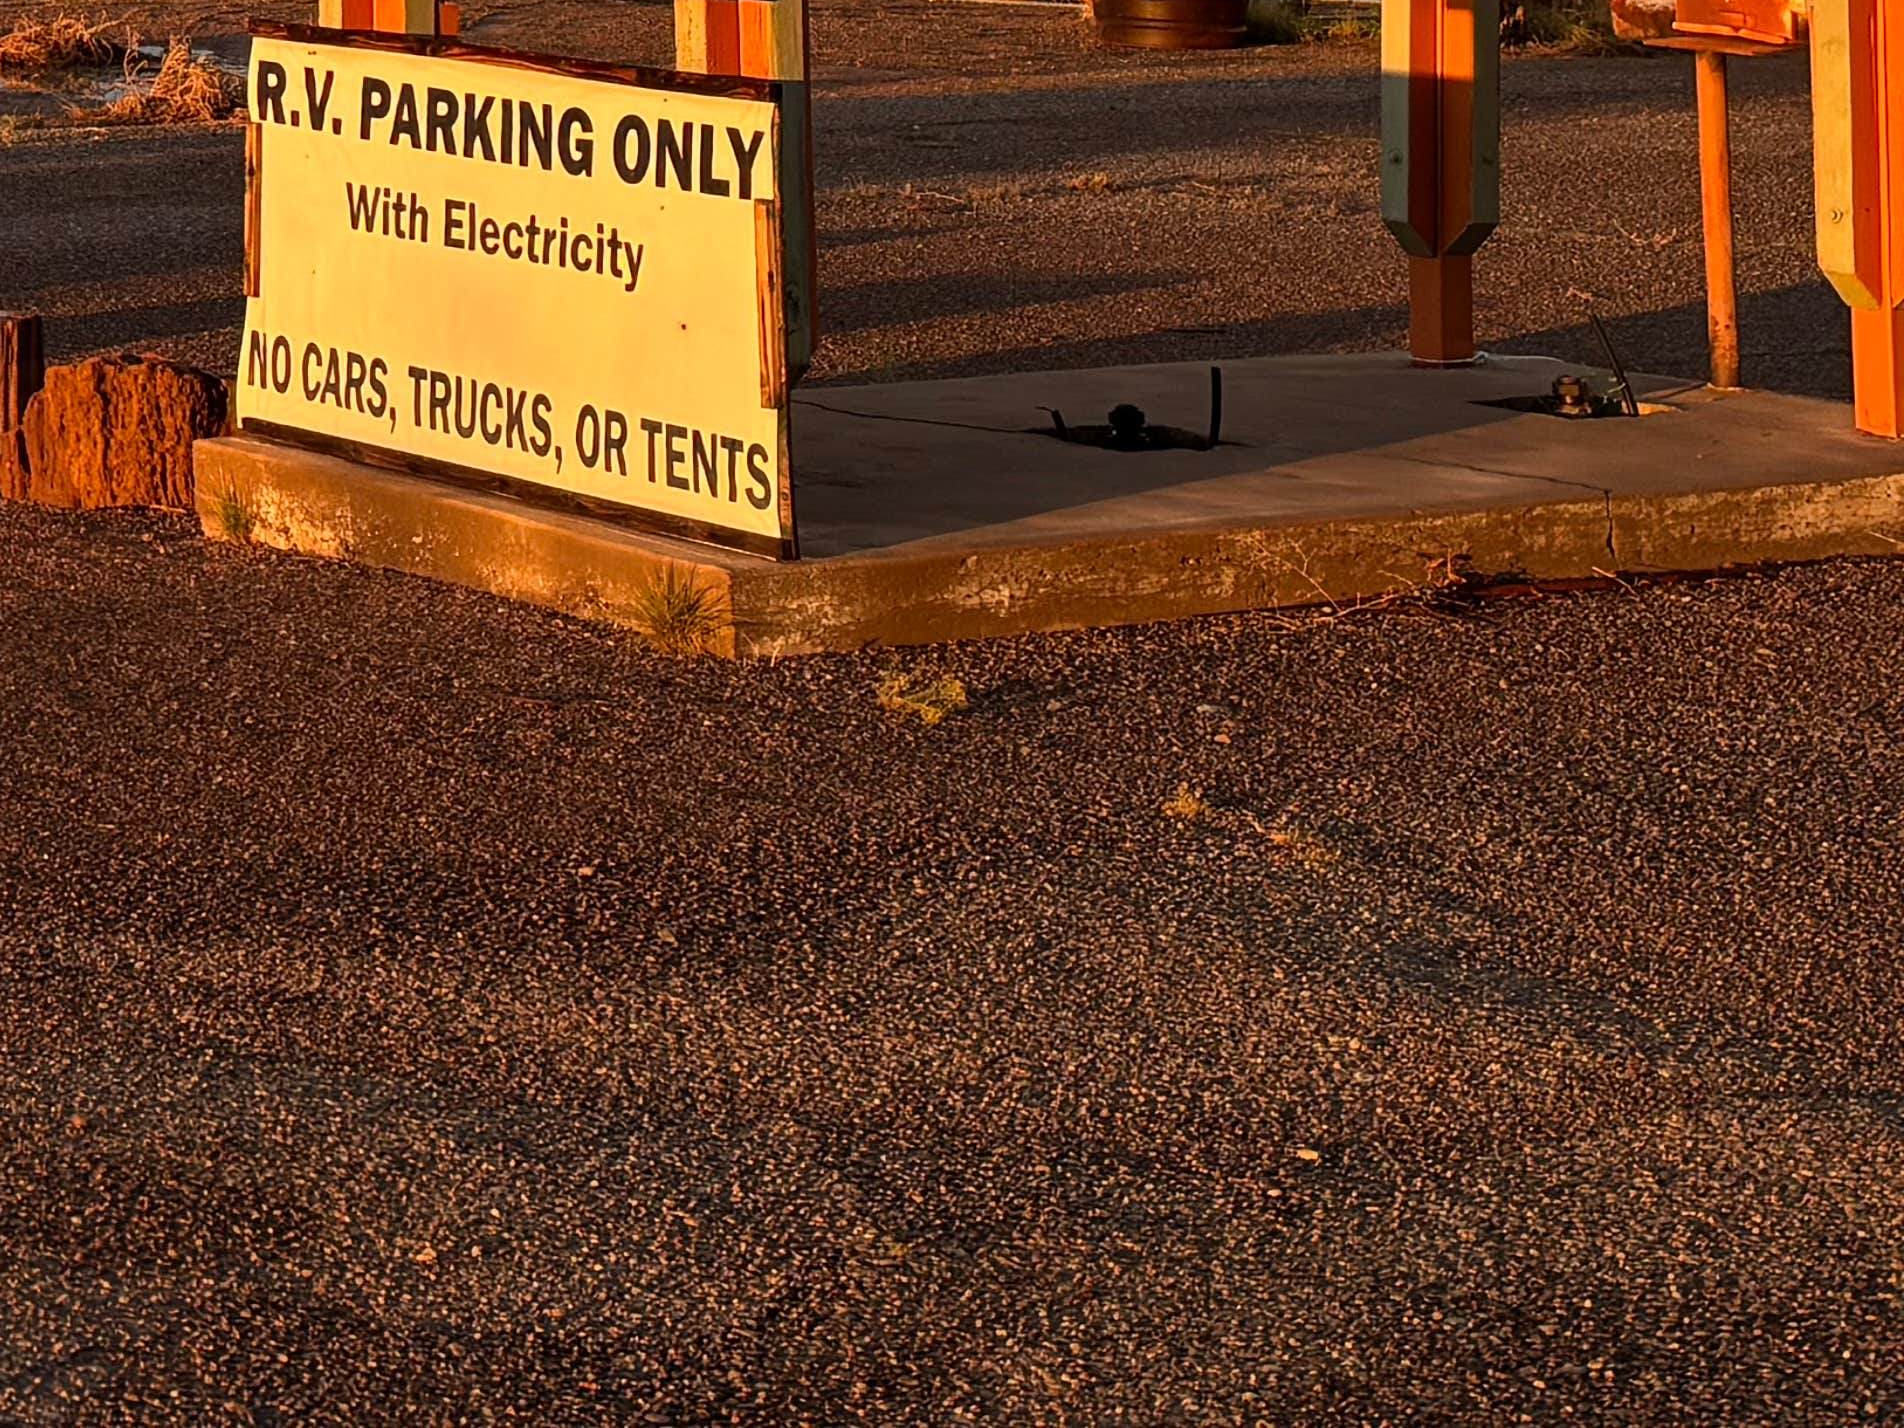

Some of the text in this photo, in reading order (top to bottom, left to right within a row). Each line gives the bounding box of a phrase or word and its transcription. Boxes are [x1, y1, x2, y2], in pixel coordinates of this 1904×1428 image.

[257, 60, 765, 200] R.V. PARKING ONLY
[345, 181, 644, 293] With Electricity
[247, 329, 772, 510] NO CARS, TRUCKS, OR TENTS
